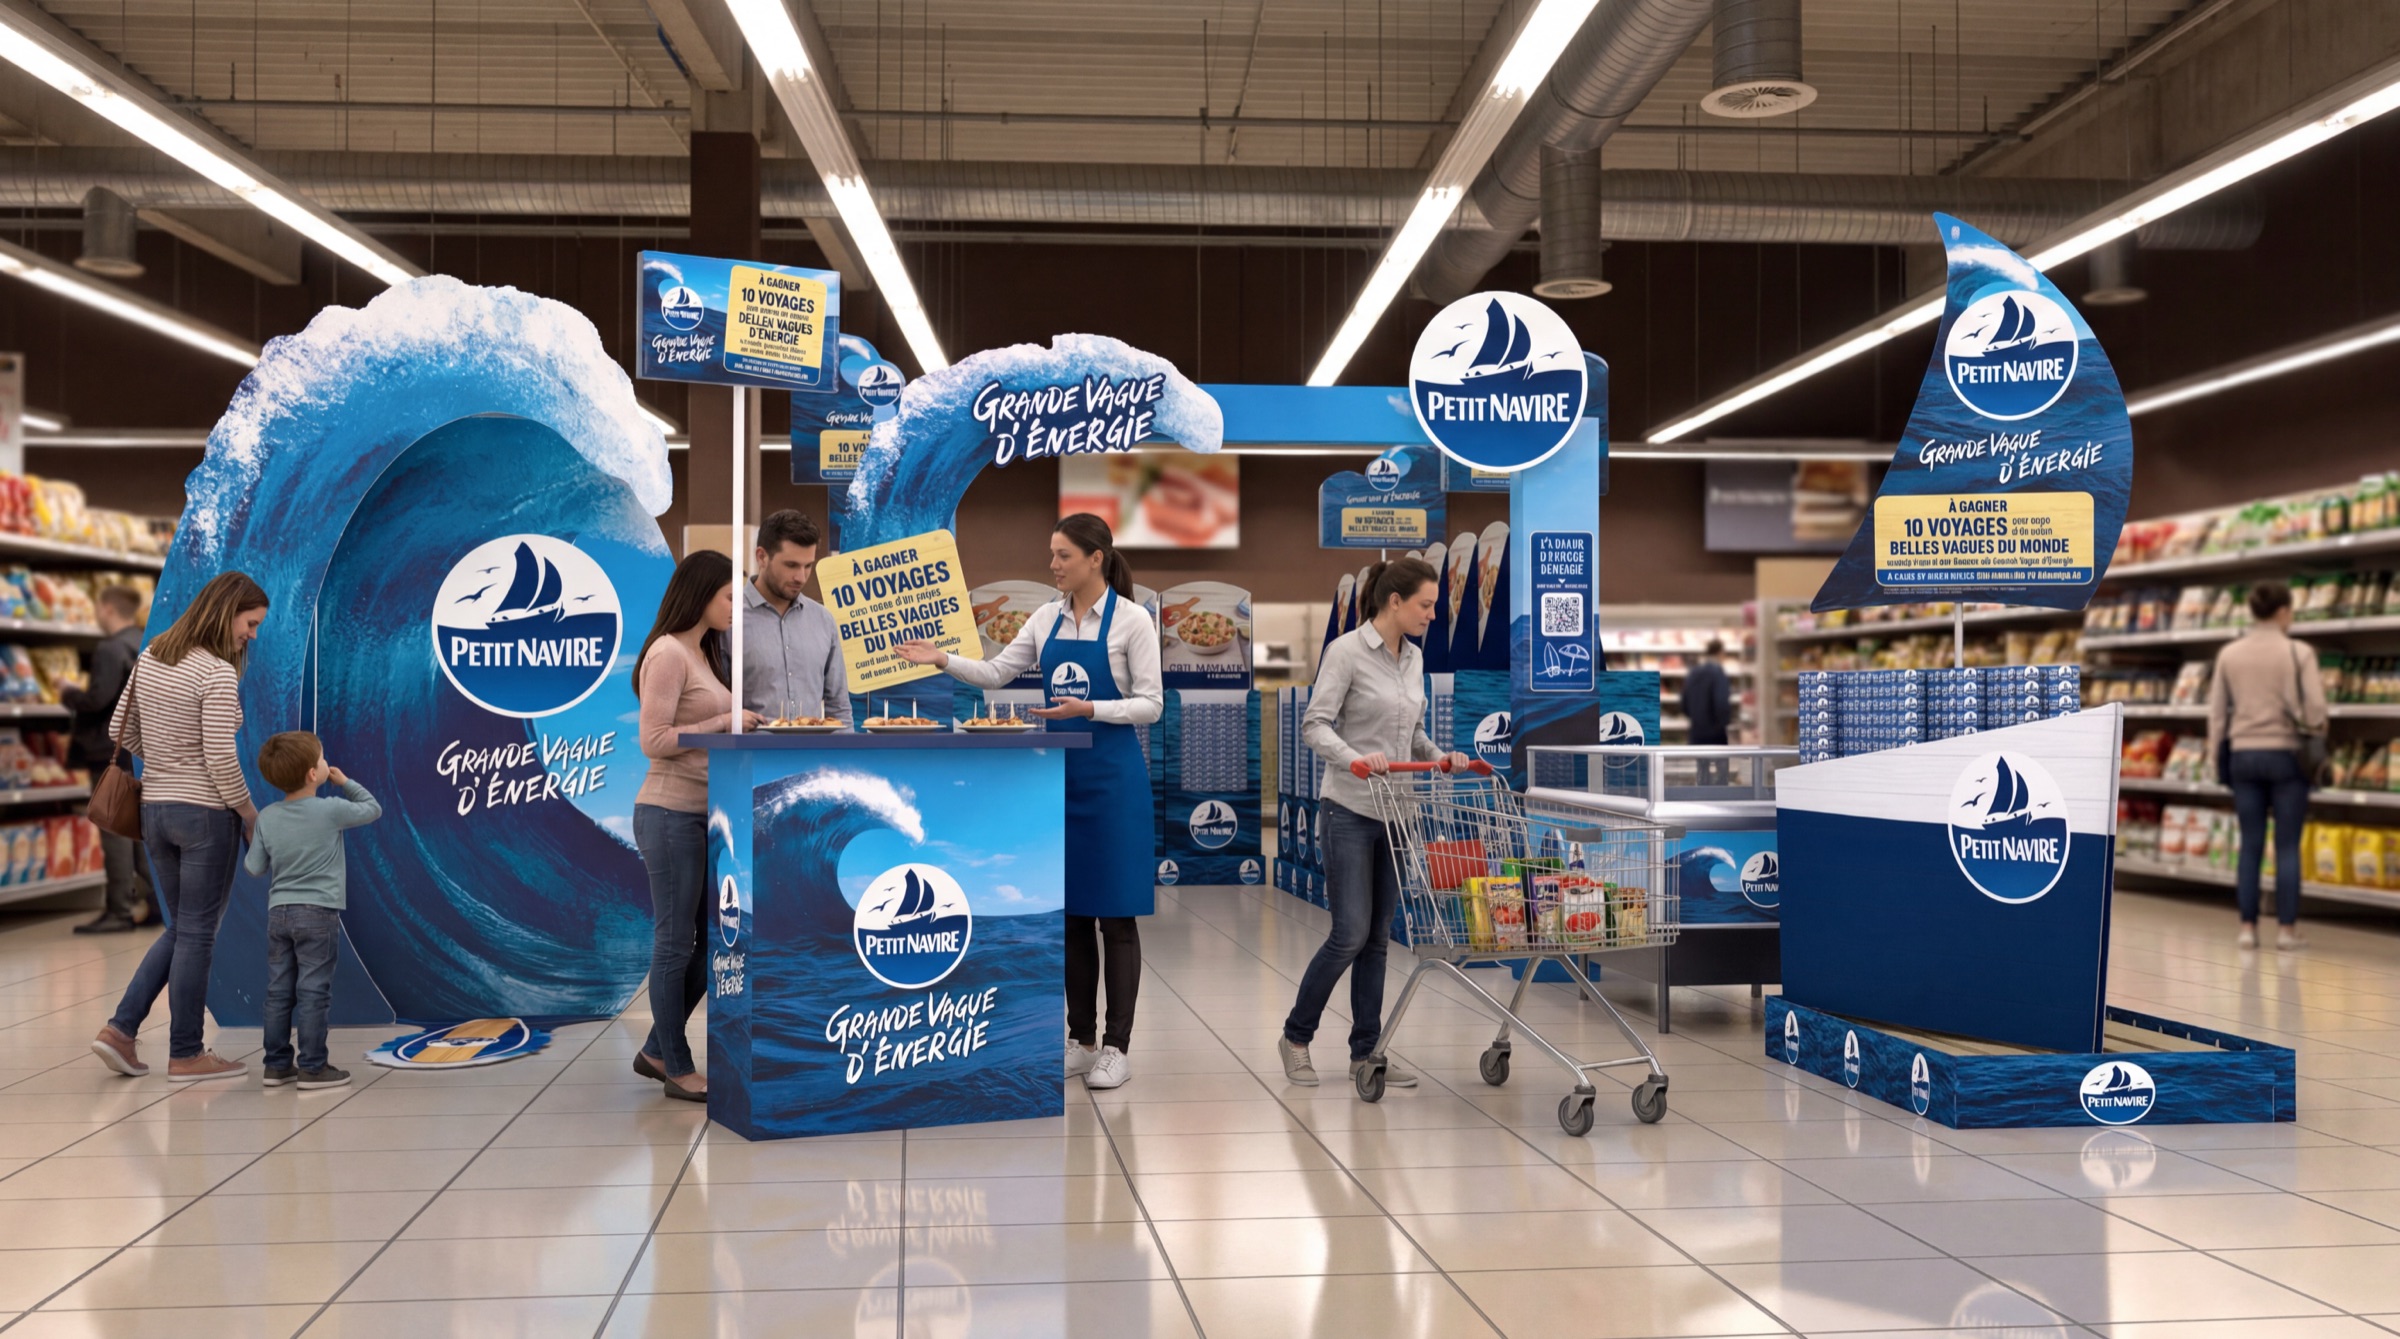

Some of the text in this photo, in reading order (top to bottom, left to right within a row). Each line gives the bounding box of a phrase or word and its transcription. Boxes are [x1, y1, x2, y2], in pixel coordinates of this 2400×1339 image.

[742, 287, 755, 302] 10
[758, 290, 815, 314] VOYAGES
[776, 319, 813, 336] VAGUES
[1957, 357, 2064, 385] PETIT NAVIRE
[972, 373, 1166, 433] GRANDE VAGUE
[1427, 391, 1570, 423] PETIT NAVIRE
[838, 443, 850, 453] 10
[1919, 429, 2042, 472] GRANDE VAGUE
[1949, 498, 2008, 513] À GAGNER
[1904, 518, 1923, 537] 10
[1927, 516, 2008, 537] VOYAGES
[1890, 538, 2069, 555] BELLES VAGUES DU MONDE
[852, 548, 919, 577] À GAGNER
[831, 584, 856, 609] 10
[857, 561, 950, 601] VOYAGES
[840, 612, 898, 641] BELLES
[898, 596, 960, 625] VAGUES
[451, 636, 603, 667] PETIT NAVIRE
[864, 635, 886, 654] DU
[888, 619, 945, 647] MONDE
[436, 731, 616, 786] GRANDE VAGUE
[1961, 833, 2060, 864] PETIT NAVIRE
[865, 930, 960, 956] PETIT NAVIRE
[825, 986, 998, 1054] GRANDE VAGUE
[2088, 1094, 2148, 1108] PETIT NAVIRE
